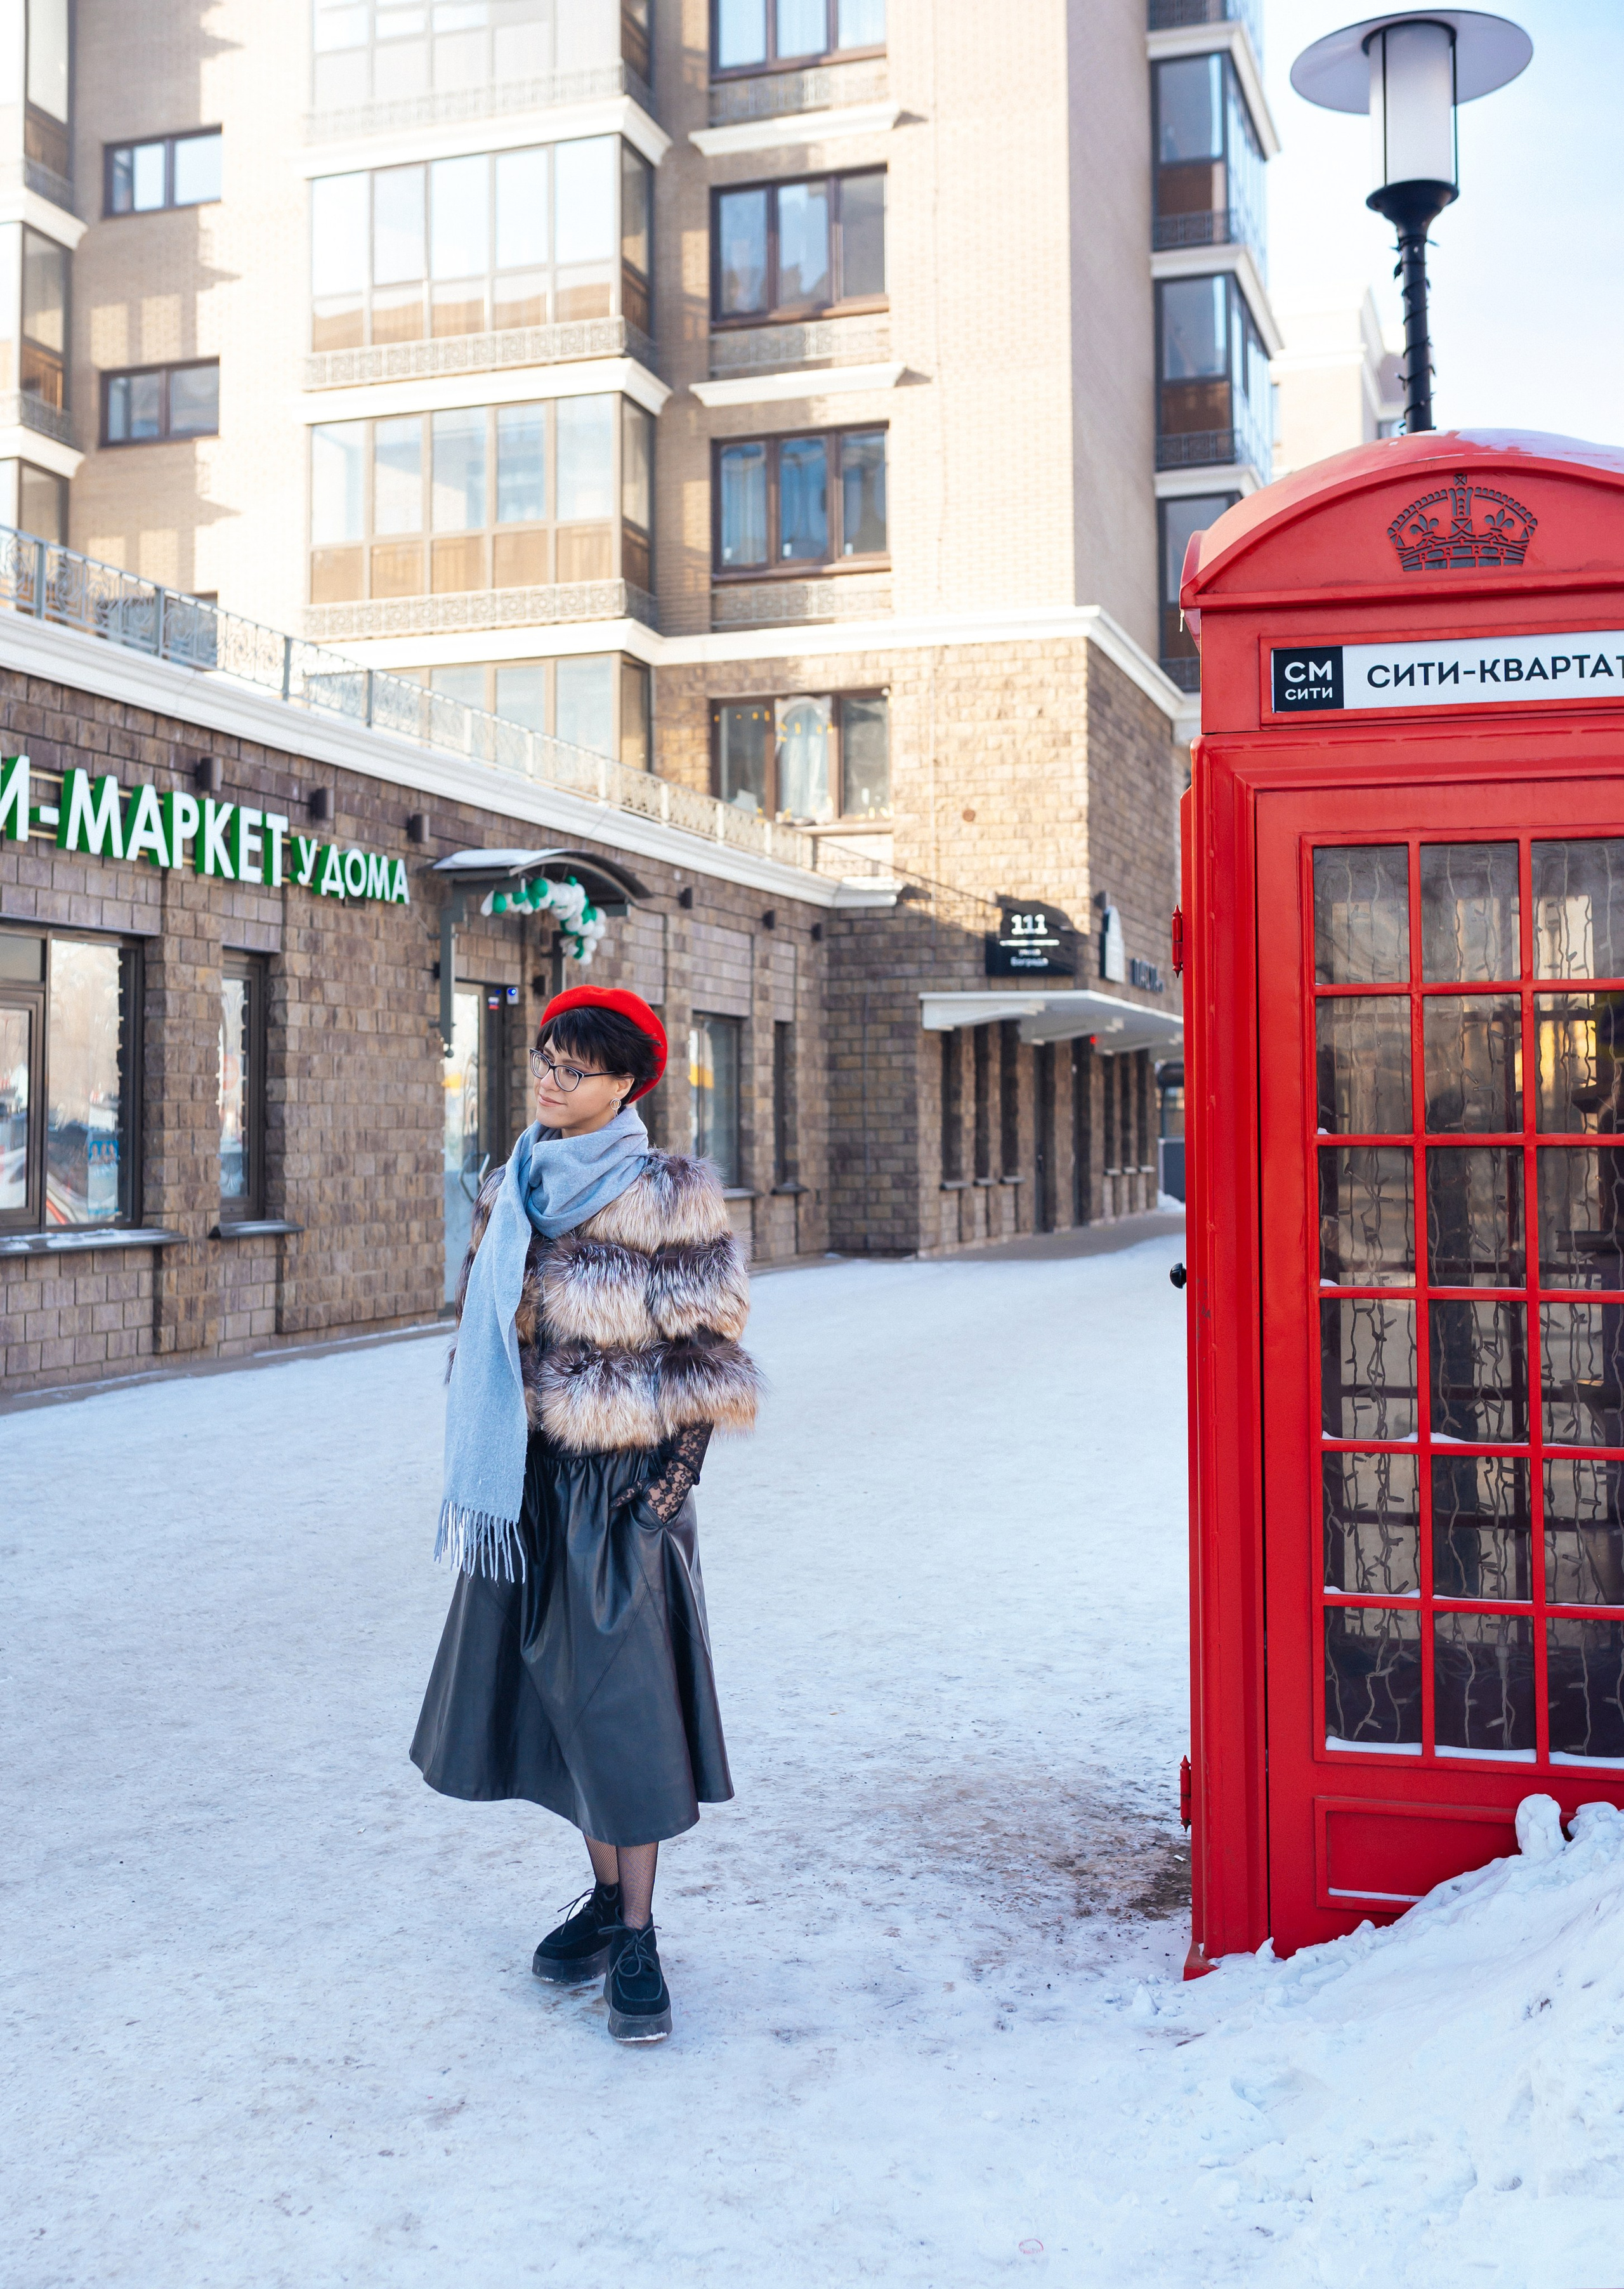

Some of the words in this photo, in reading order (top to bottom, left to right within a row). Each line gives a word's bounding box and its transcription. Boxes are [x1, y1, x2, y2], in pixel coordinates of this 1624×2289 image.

[1284, 660, 1333, 683] СМ
[1285, 686, 1333, 701] СИТИ
[315, 843, 411, 905] ДОМА
[1011, 914, 1048, 935] 111
